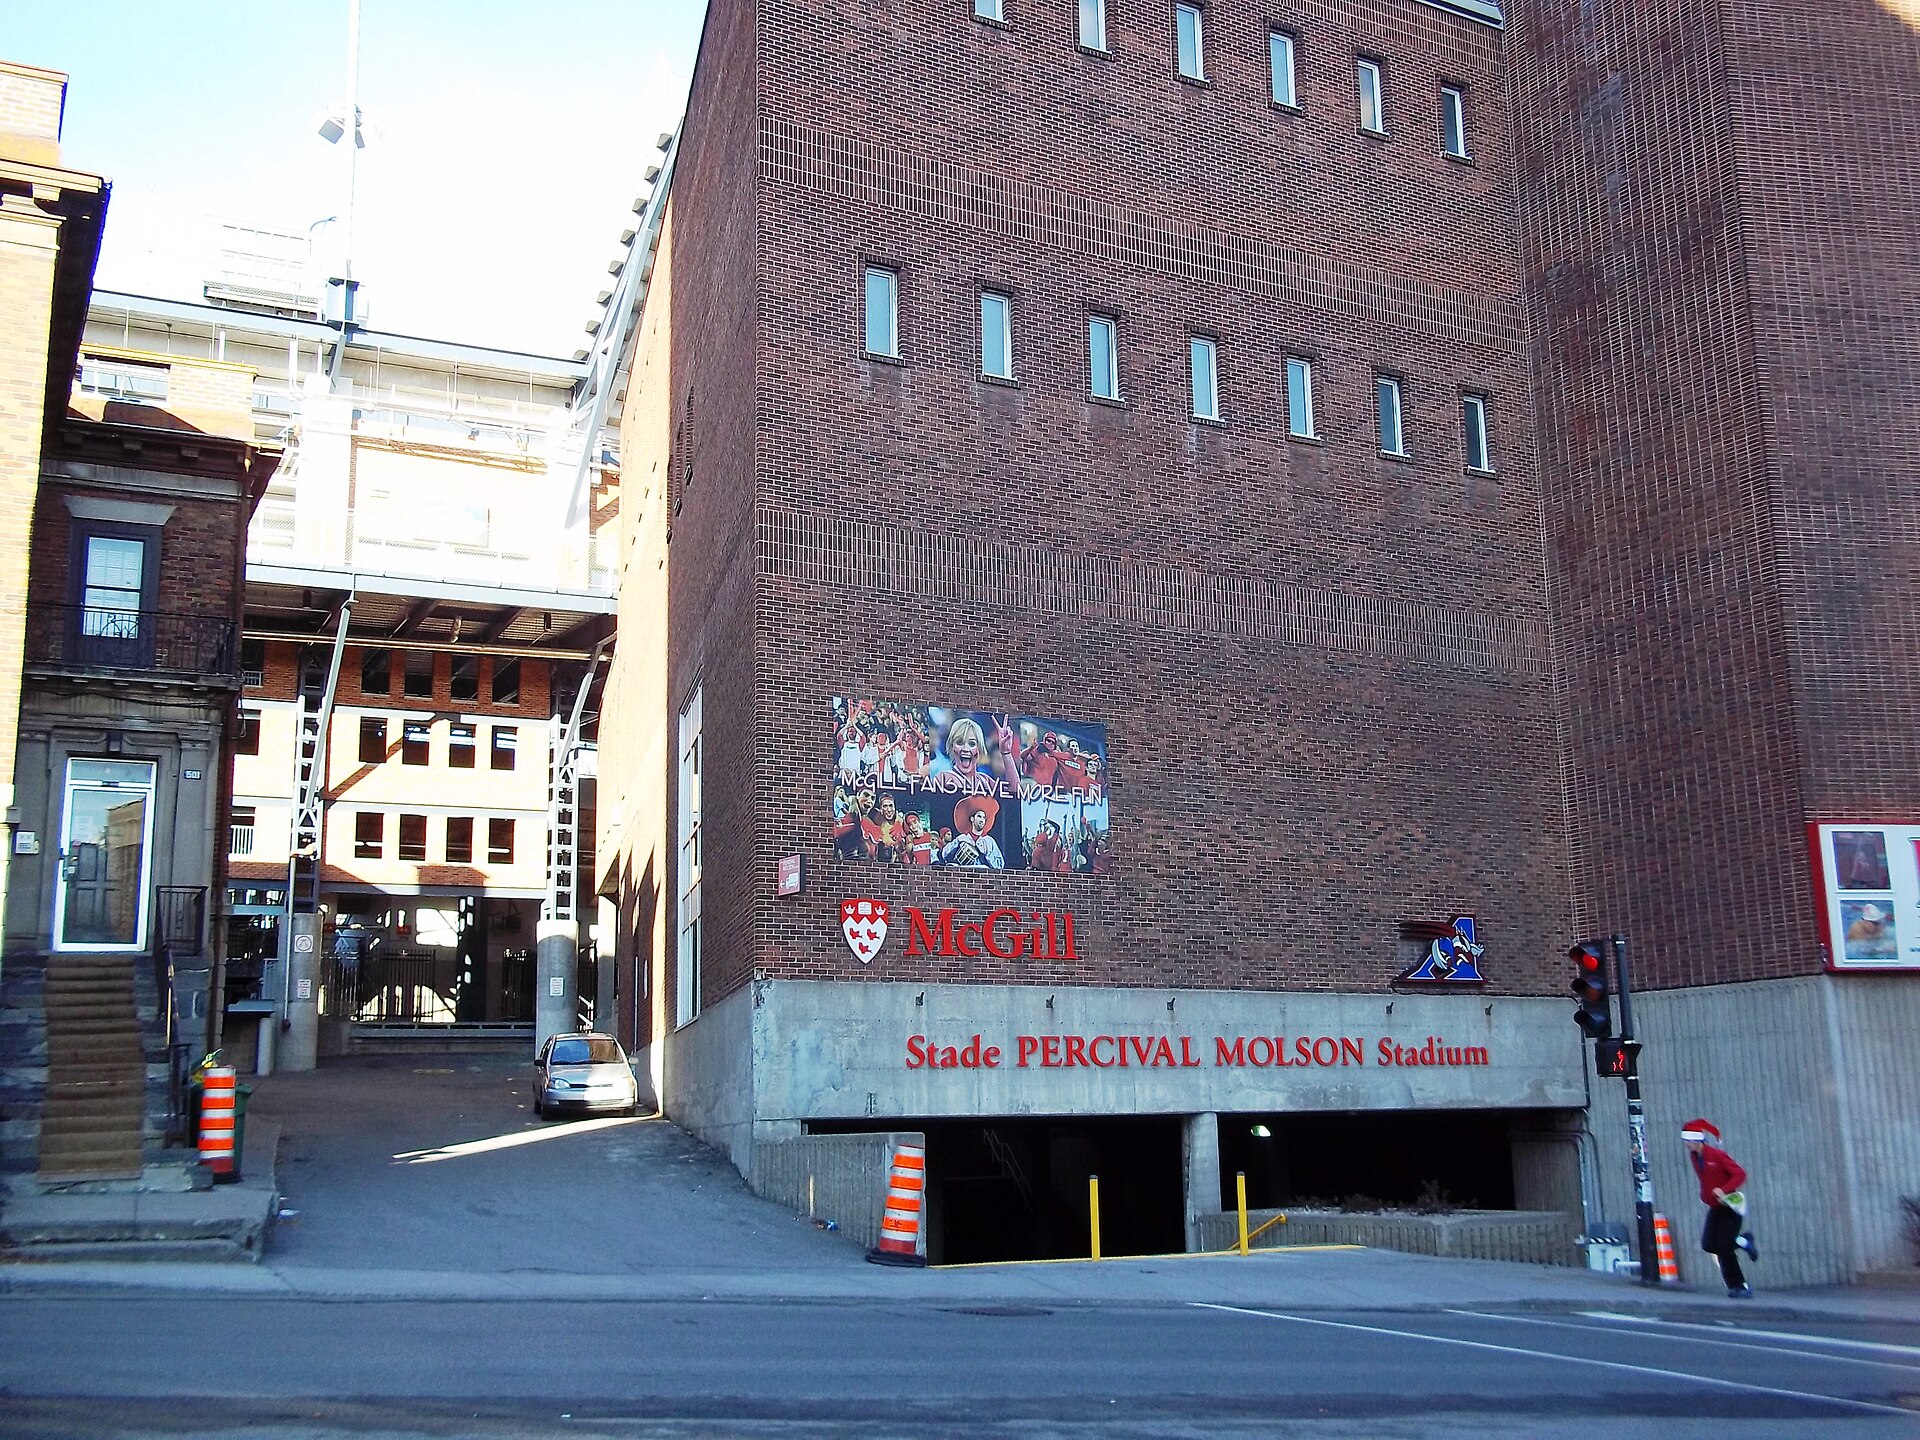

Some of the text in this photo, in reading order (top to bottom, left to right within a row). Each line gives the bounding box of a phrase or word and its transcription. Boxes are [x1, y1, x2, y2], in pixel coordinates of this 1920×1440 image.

[841, 769, 1102, 806] McGILL FANS HAVE MORE FUN
[903, 907, 1080, 960] McGill
[906, 1034, 1489, 1068] Stade PERCIVAL MOLSON Stadium
